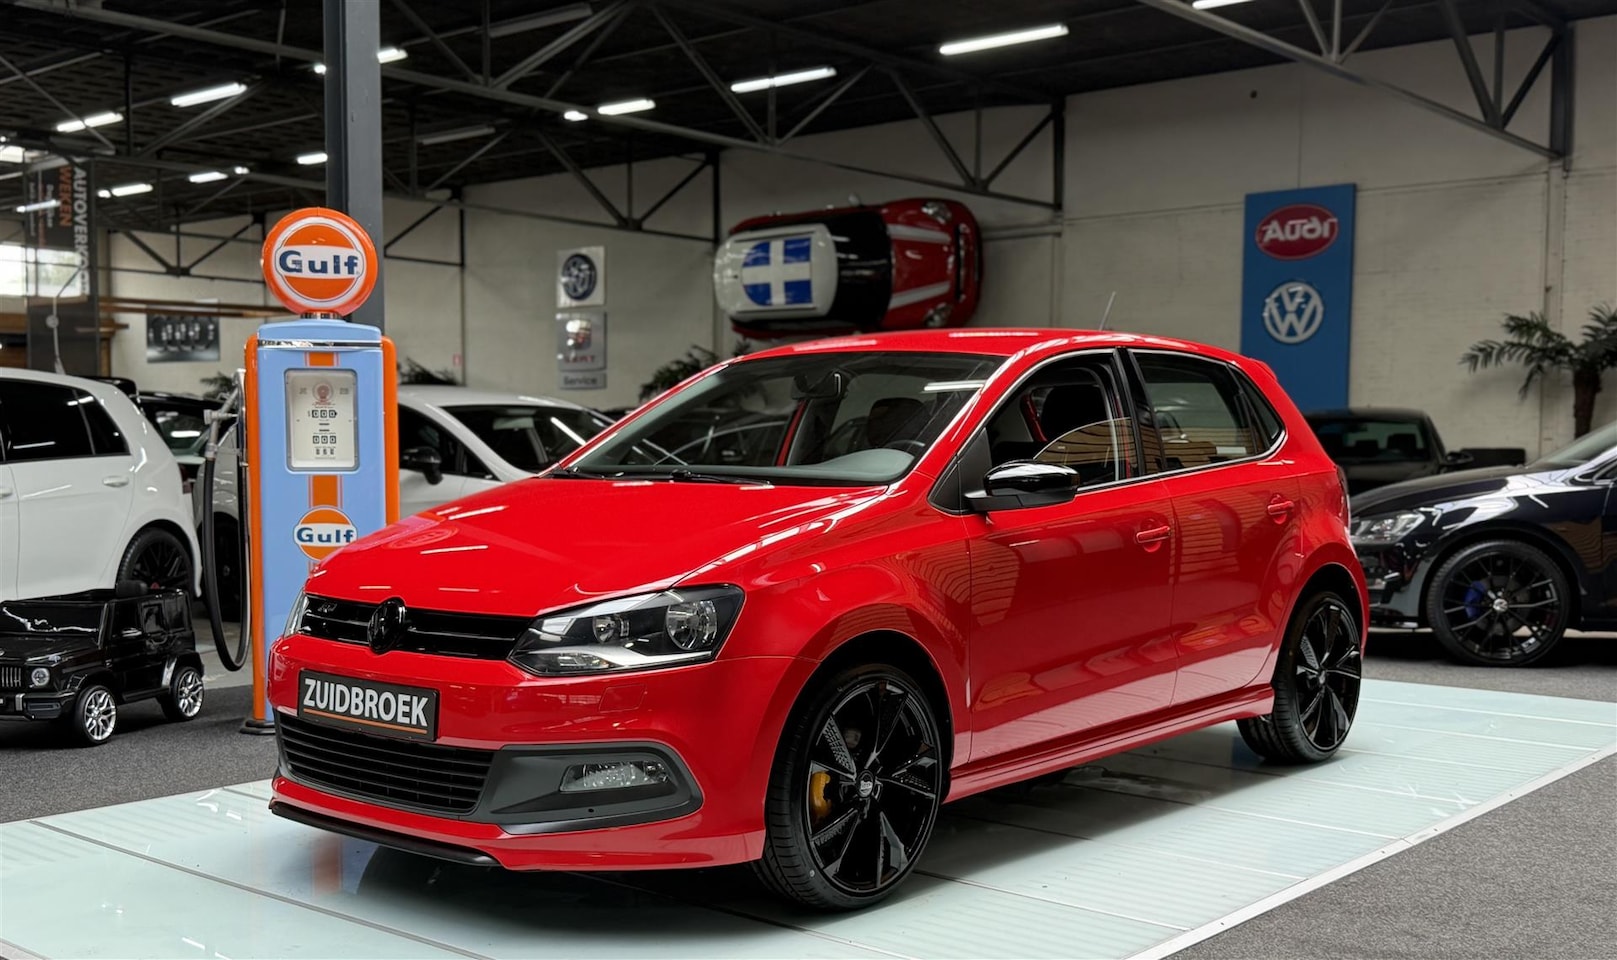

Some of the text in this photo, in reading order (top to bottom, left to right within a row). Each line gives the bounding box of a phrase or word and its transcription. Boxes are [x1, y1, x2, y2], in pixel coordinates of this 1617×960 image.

[59, 166, 72, 226] WEKEN
[279, 250, 359, 275] Gulf
[563, 375, 597, 386] Service
[296, 527, 354, 543] Gulf
[303, 678, 428, 727] ZUIDBROEK
